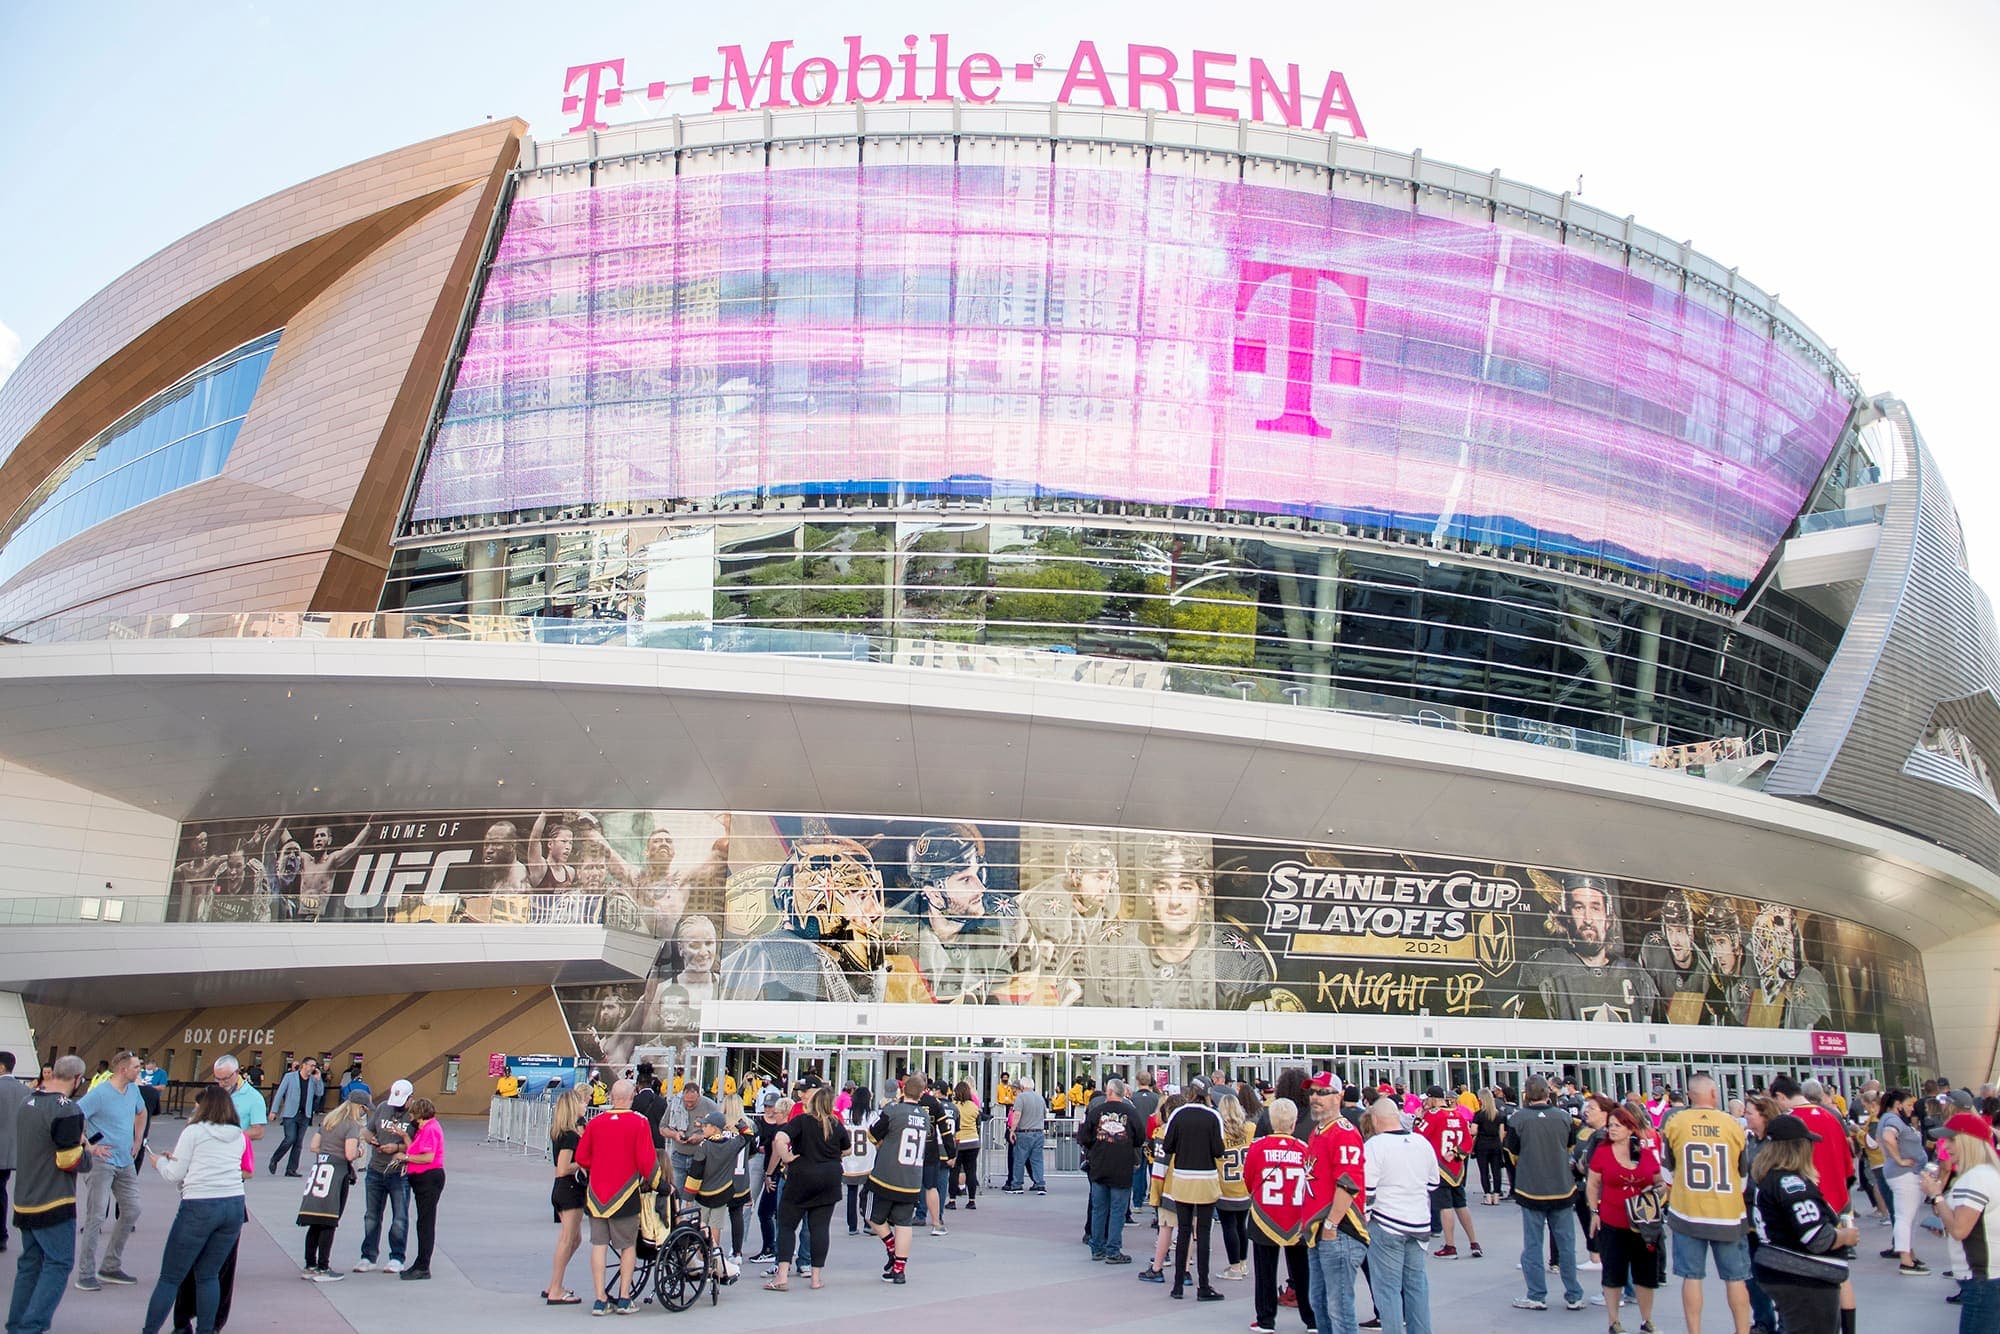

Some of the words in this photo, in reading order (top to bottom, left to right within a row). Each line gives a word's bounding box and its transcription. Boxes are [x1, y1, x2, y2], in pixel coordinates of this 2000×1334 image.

[1057, 40, 1368, 142] ARENA
[1234, 259, 1368, 439] T
[380, 824, 427, 839] HOME
[438, 822, 461, 837] OF
[344, 850, 473, 908] UFC
[1270, 866, 1440, 904] STANLEY
[1443, 876, 1517, 910] CUP
[1271, 903, 1466, 938] PLAYOFFS
[1405, 941, 1449, 954] 2021
[1316, 967, 1439, 1014] KNIGHT
[1445, 972, 1493, 1015] UP
[1623, 979, 1634, 1005] C
[184, 1028, 213, 1044] BOX
[218, 1028, 275, 1045] OFFICE
[381, 1119, 410, 1132] VEAS
[1692, 1125, 1721, 1138] STONE
[898, 1127, 927, 1167] 61
[1263, 1149, 1303, 1164] THEODORE
[1339, 1146, 1361, 1165] 17
[1684, 1142, 1733, 1193] 61
[1261, 1167, 1306, 1206] 27
[1792, 1200, 1821, 1224] 29
